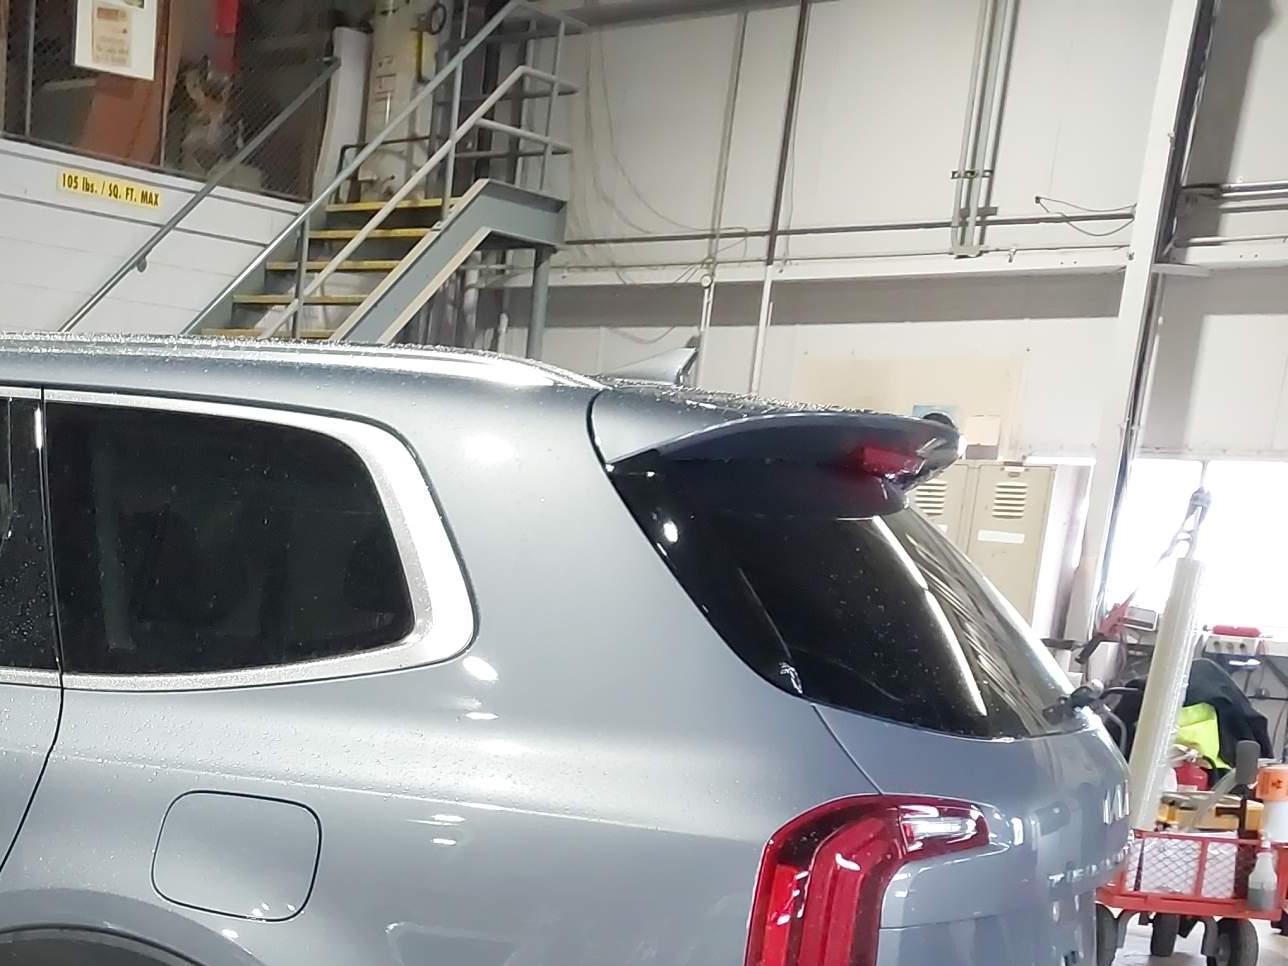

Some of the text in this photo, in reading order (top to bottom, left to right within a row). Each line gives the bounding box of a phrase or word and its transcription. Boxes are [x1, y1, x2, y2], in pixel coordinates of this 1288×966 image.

[62, 173, 78, 189] 105
[82, 177, 98, 194] lbs.
[109, 183, 122, 199] SQ.
[126, 187, 137, 202] FT.
[141, 190, 160, 206] MAX
